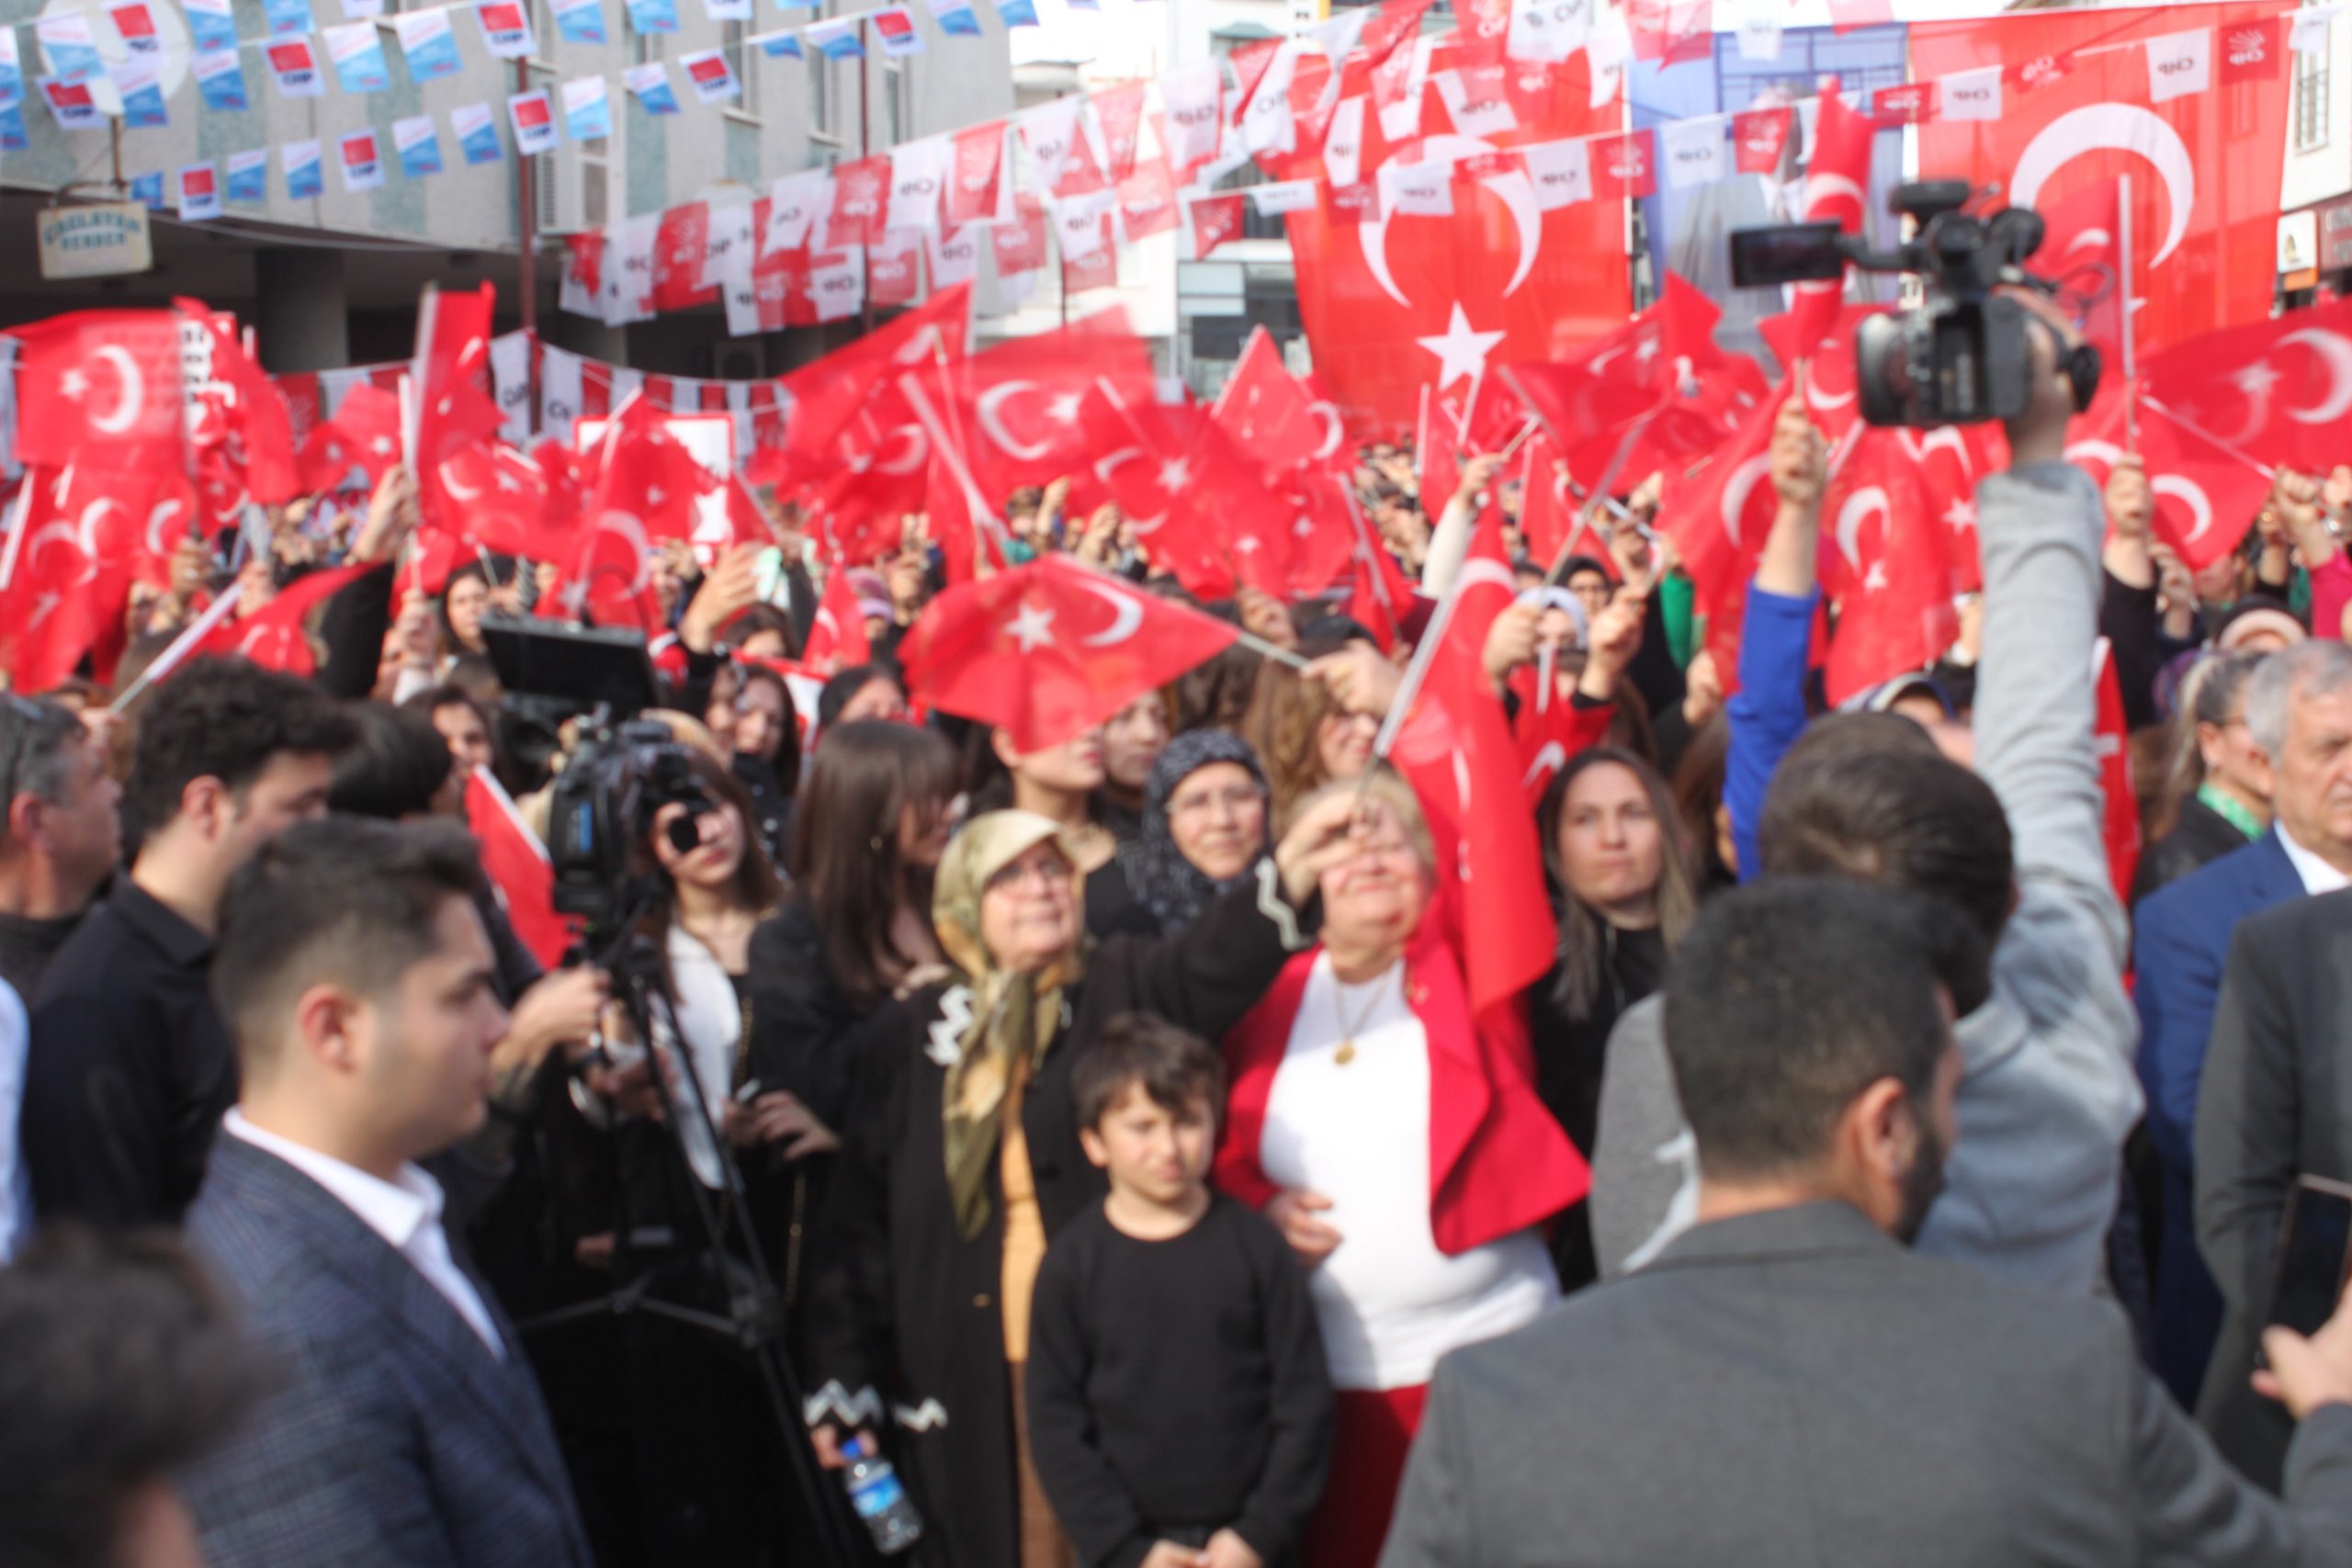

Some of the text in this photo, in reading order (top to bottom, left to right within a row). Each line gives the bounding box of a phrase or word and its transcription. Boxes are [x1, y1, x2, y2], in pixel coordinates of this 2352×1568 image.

[492, 32, 524, 44] CHP
[281, 72, 313, 85] CHP
[525, 127, 550, 139] CHP
[350, 165, 376, 177] CHP
[187, 196, 213, 208] CHP
